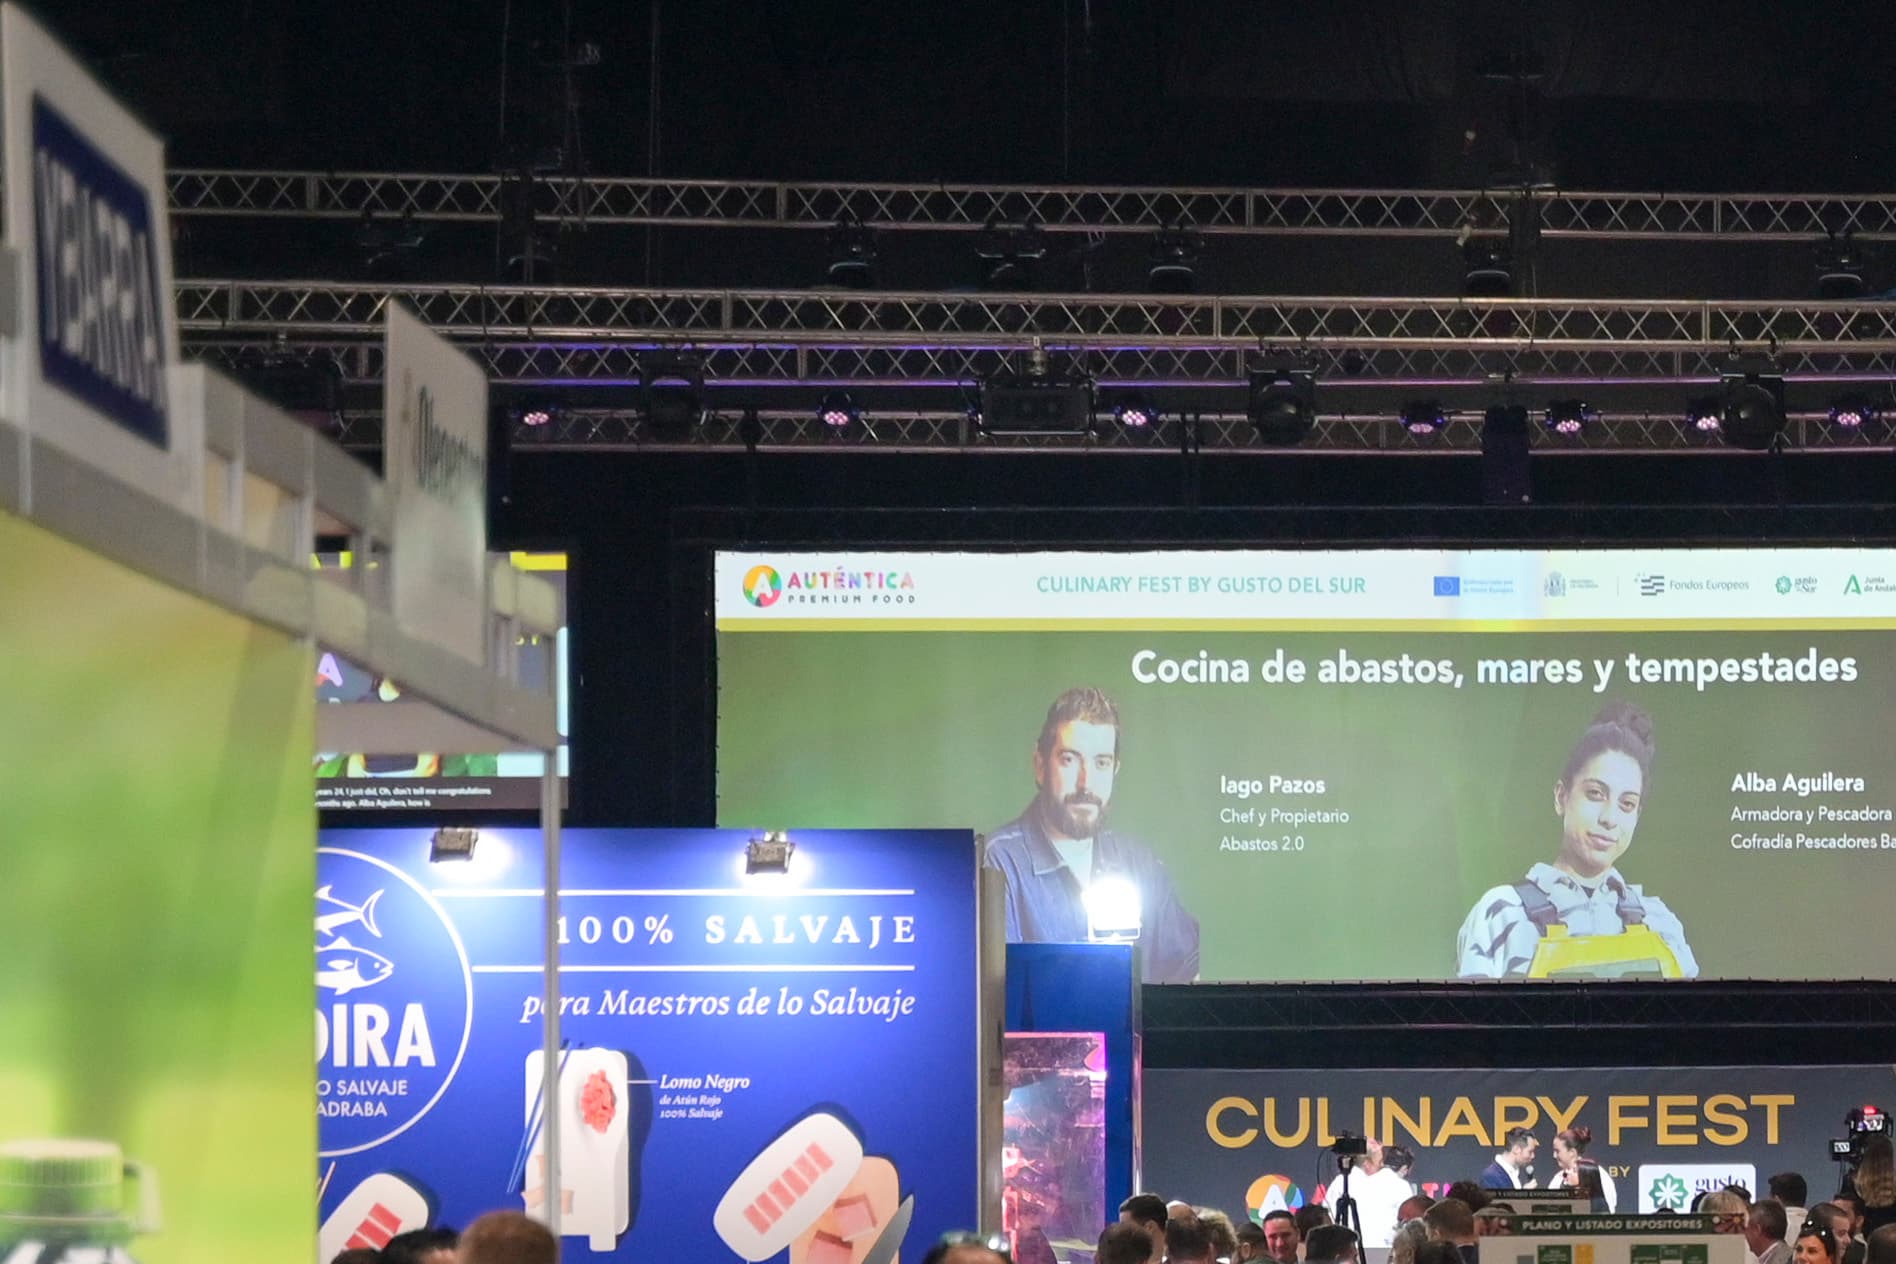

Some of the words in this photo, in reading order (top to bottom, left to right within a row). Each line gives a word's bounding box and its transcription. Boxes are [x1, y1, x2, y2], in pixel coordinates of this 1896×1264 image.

[787, 566, 915, 589] AUTÉNTICA
[1036, 577, 1132, 595] CULINARY
[1138, 576, 1183, 594] FEST
[1188, 577, 1212, 594] BY
[1217, 576, 1281, 594] GUSTO
[1288, 576, 1324, 594] DEL
[1328, 576, 1366, 594] SUR
[1670, 580, 1704, 591] Fondos
[1706, 579, 1750, 593] Europeos
[788, 595, 861, 604] PREMIUM
[873, 595, 915, 604] FOOD
[1131, 650, 1251, 685] Cocina
[1260, 650, 1307, 684] de
[1318, 649, 1463, 688] abastos,
[1476, 660, 1583, 684] mares
[1592, 660, 1613, 693] y
[1625, 648, 1858, 693] tempestades
[1220, 775, 1263, 798] Iago
[1269, 775, 1326, 795] Pazos
[1731, 772, 1777, 793] Alba
[1782, 773, 1865, 798] Aguilera
[1220, 806, 1254, 825] Chef
[1256, 811, 1266, 829] y
[1271, 807, 1349, 829] Propietario
[1731, 805, 1801, 823] Armadora
[1804, 810, 1814, 828] y
[1818, 805, 1893, 823] Pescadora
[1220, 834, 1277, 852] Abastos
[1282, 834, 1305, 852] 2.0
[1731, 833, 1793, 852] Cofradía
[1796, 833, 1877, 852] Pescadores
[557, 915, 674, 945] 100%
[705, 915, 916, 949] SALVAJE
[520, 993, 591, 1025] pra
[597, 990, 731, 1017] Maestros
[737, 987, 769, 1016] de
[777, 987, 804, 1016] lo
[810, 988, 916, 1024] Salvaje
[337, 1079, 408, 1096] SALVAJE
[660, 1074, 702, 1089] Lomo
[704, 1074, 750, 1093] Negro
[316, 1101, 388, 1117] ADRABA
[659, 1094, 671, 1105] de
[672, 1094, 698, 1105] Atún
[699, 1095, 722, 1107] Rojo
[660, 1110, 687, 1119] 100%
[688, 1107, 724, 1120] Salvaje
[1206, 1096, 1589, 1149] CULINARY
[1608, 1094, 1795, 1146] FEST
[1608, 1166, 1631, 1178] BY
[1522, 1220, 1562, 1230] PLANO
[1565, 1220, 1573, 1229] Y
[1576, 1219, 1622, 1230] LISTADO
[1626, 1219, 1703, 1230] EXPOSITORES
